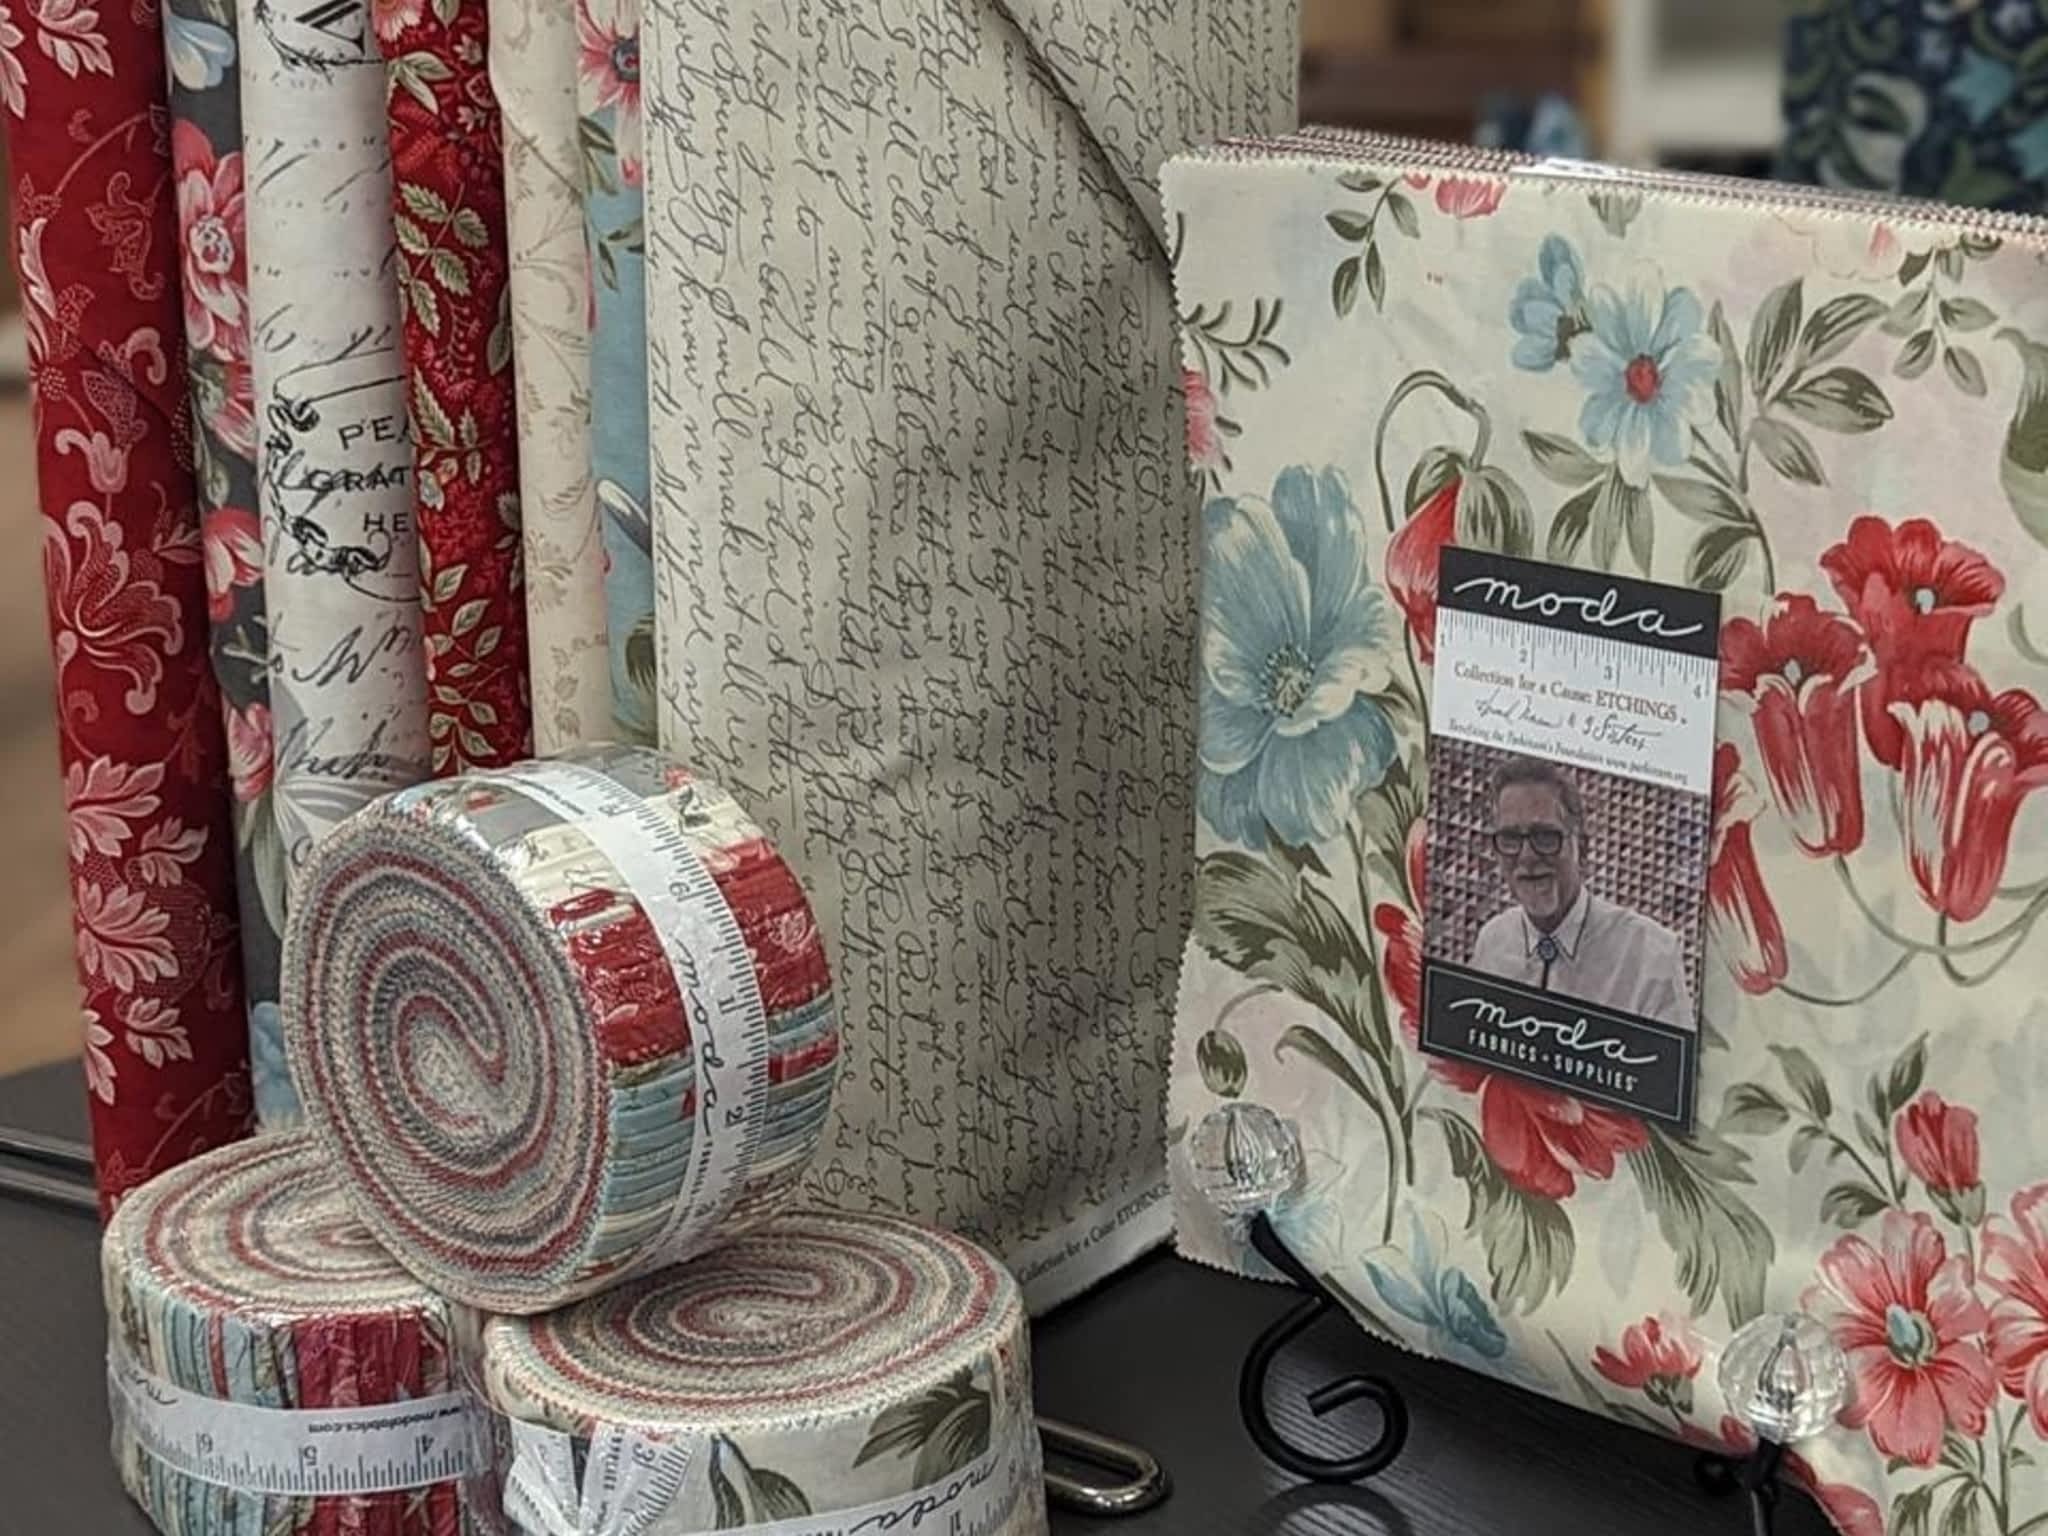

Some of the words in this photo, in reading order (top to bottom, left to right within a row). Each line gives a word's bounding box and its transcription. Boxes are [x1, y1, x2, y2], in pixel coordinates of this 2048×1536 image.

[737, 141, 777, 256] you
[1453, 577, 1703, 637] moda
[719, 631, 769, 696] all
[1454, 661, 1517, 689] Collection
[1518, 673, 1537, 691] for
[668, 880, 690, 903] 6
[668, 934, 724, 1137] moda
[1449, 998, 1658, 1064] moda
[1468, 1028, 1537, 1062] FABRICS
[1554, 1055, 1636, 1092] SUPPLIES
[725, 1107, 744, 1123] 2
[200, 1433, 214, 1455] 6
[303, 1445, 318, 1467] 5
[849, 1454, 1000, 1536] moda
